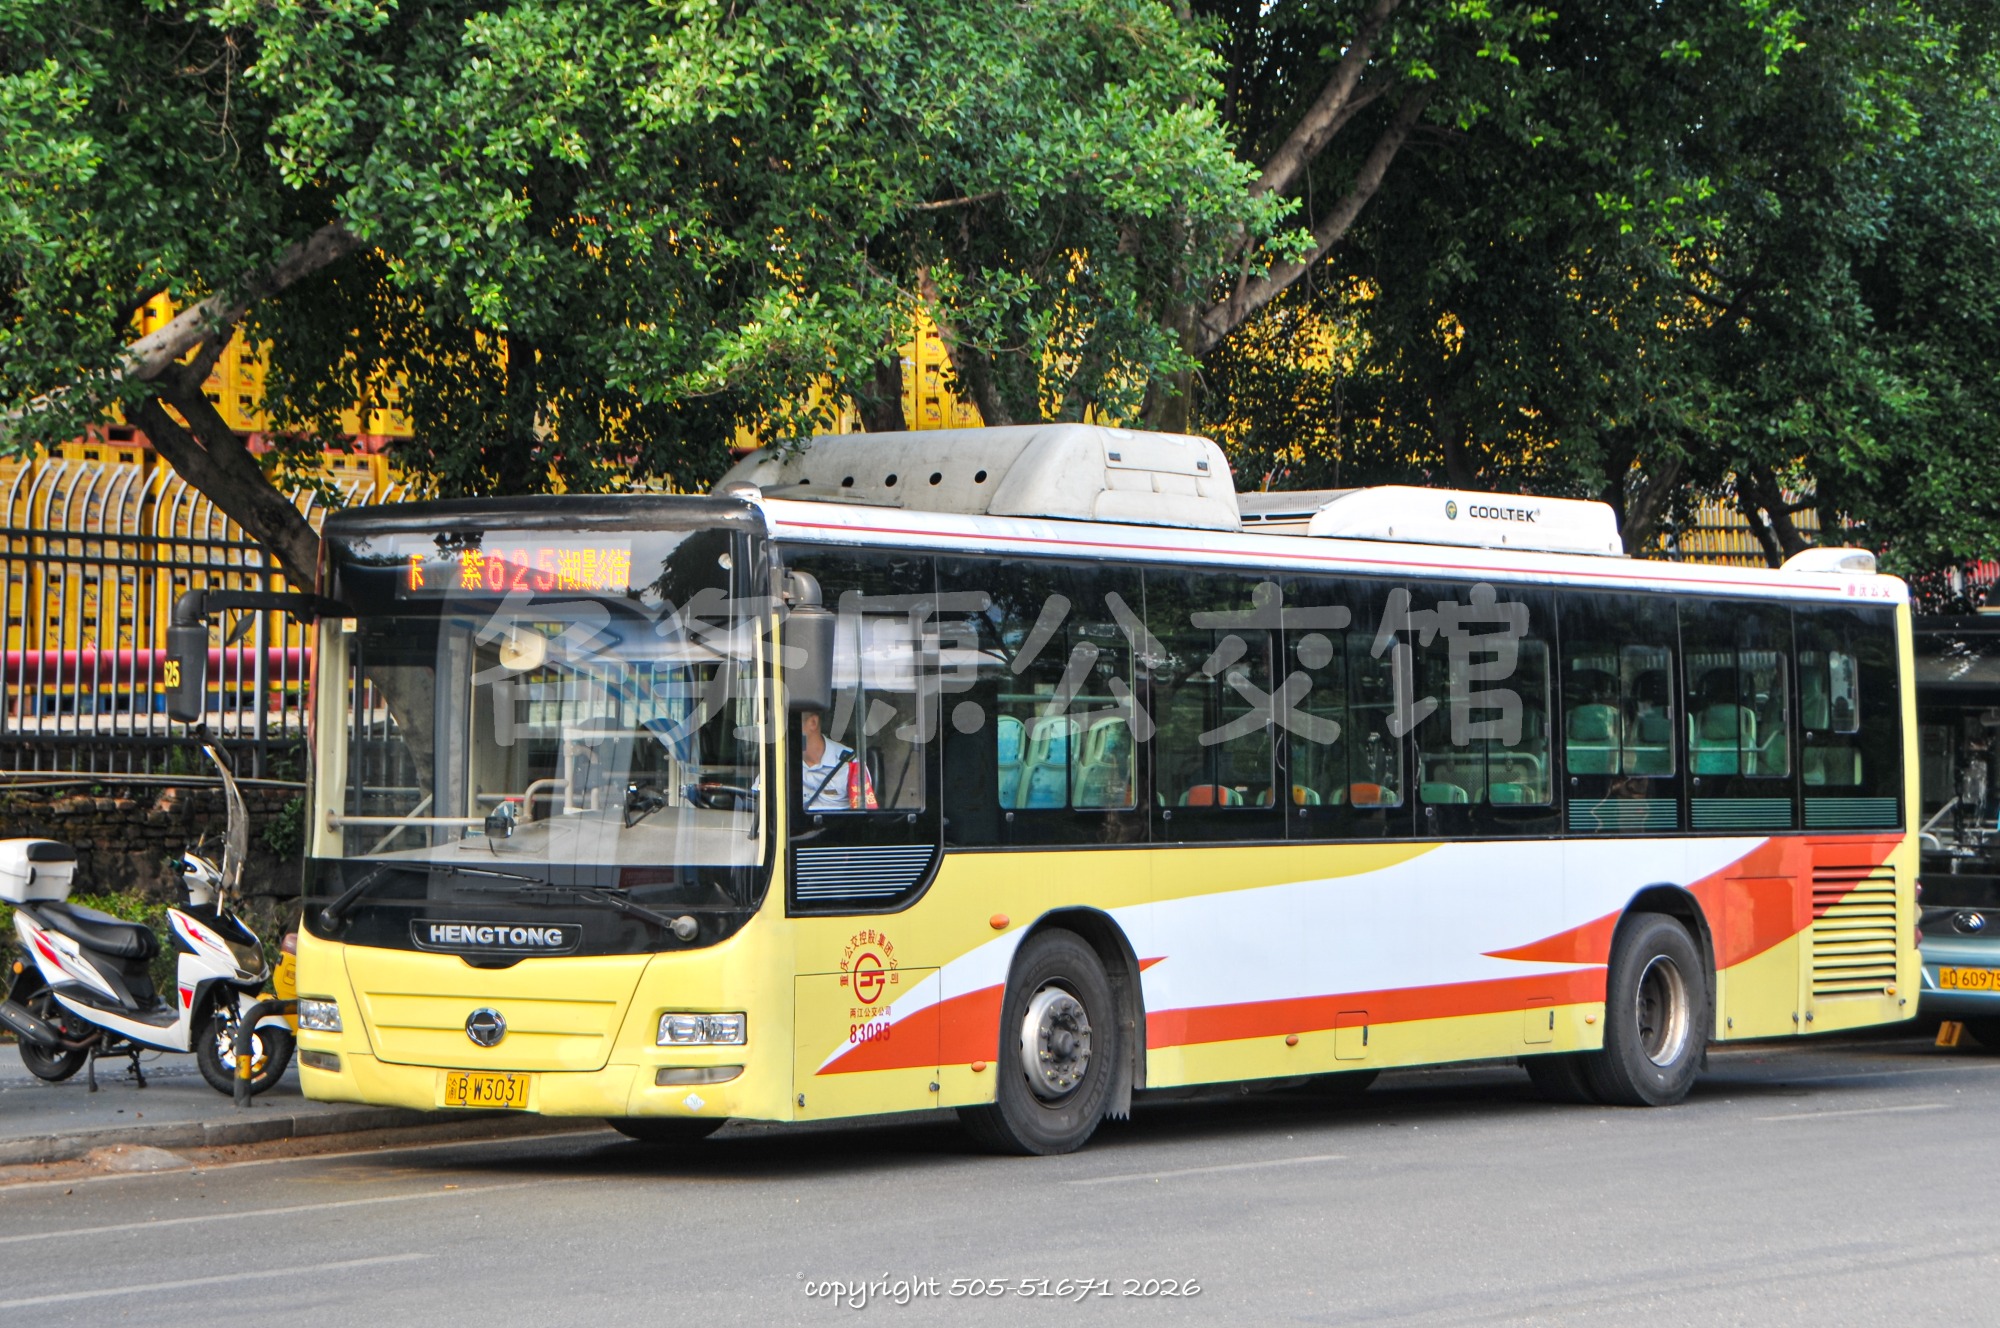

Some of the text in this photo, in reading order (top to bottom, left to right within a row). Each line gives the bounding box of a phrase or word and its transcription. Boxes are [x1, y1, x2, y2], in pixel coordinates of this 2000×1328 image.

[1469, 505, 1536, 523] COOLTEK
[429, 924, 563, 947] HENGTONG
[849, 1006, 892, 1019] 两江公交公司
[849, 1022, 891, 1044] 83085
